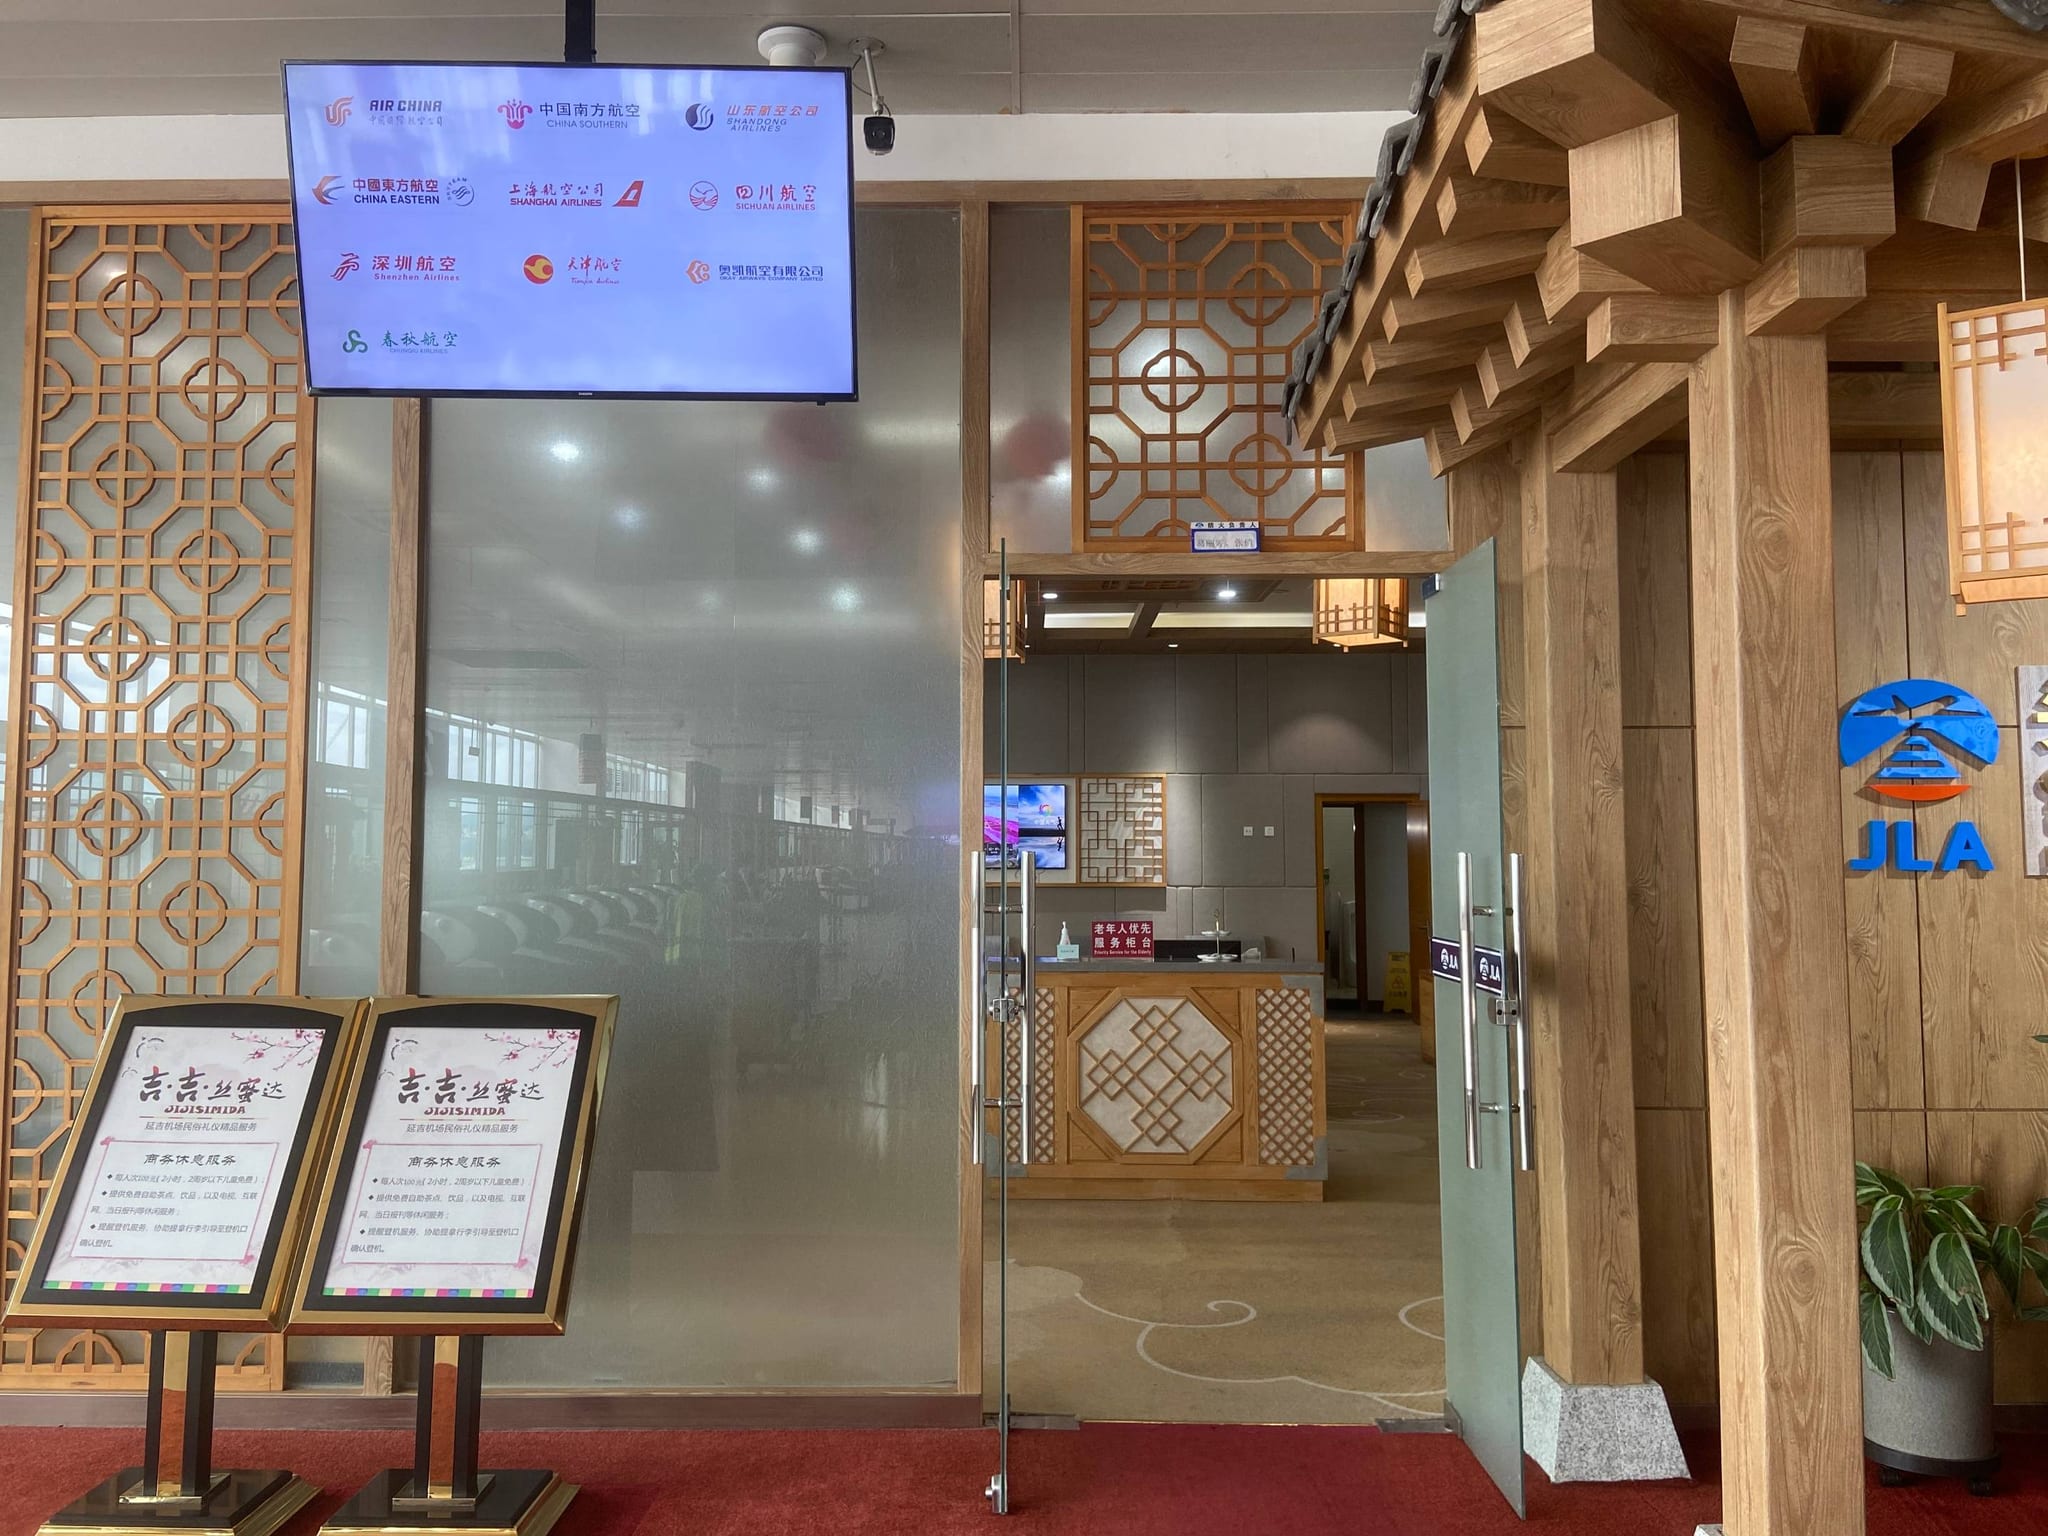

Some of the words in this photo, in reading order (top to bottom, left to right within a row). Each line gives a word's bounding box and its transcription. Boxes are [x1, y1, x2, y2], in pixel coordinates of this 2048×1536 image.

[369, 100, 394, 112] AIR
[397, 100, 443, 112] CHINA
[539, 101, 641, 118] 中国南方航空
[726, 104, 819, 117] 山东航空公司
[546, 119, 578, 128] CHINA
[579, 119, 628, 129] SOUTHERN
[726, 117, 788, 126] SHANDONG
[730, 124, 782, 133] AIRLINES
[352, 177, 439, 193] 中國東方航空
[508, 180, 604, 198] 上海航空公司
[353, 194, 388, 204] CHINA
[390, 194, 440, 205] EASTERN
[735, 183, 817, 203] 四川航空
[509, 197, 558, 206] SHANGHAI
[560, 198, 603, 207] AIRLINES
[735, 202, 775, 211] SICHUAN
[776, 203, 816, 211] AIRLINES
[371, 254, 457, 272] 深圳航空
[567, 254, 623, 277] 天津航空
[373, 272, 420, 281] Shenzhen
[423, 273, 461, 282] Airlines
[718, 264, 824, 277] 奥凯航空有限公司
[381, 329, 459, 348] 春秋航空
[1847, 819, 1996, 872] JLA
[1093, 922, 1152, 935] 老年人优先
[1093, 936, 1152, 949] 服务柜台
[1448, 954, 1459, 970] JLA
[1489, 964, 1501, 982] JLA
[163, 1105, 247, 1115] JIJISIMIDA
[423, 1107, 507, 1116] JIJISIMIDA
[144, 1120, 258, 1132] 延吉机场民俗礼仪精品服务
[405, 1122, 520, 1134] 延吉机场民俗礼仪精品服务
[143, 1153, 237, 1166] 商务休息服务
[407, 1155, 502, 1169] 商务休息服务
